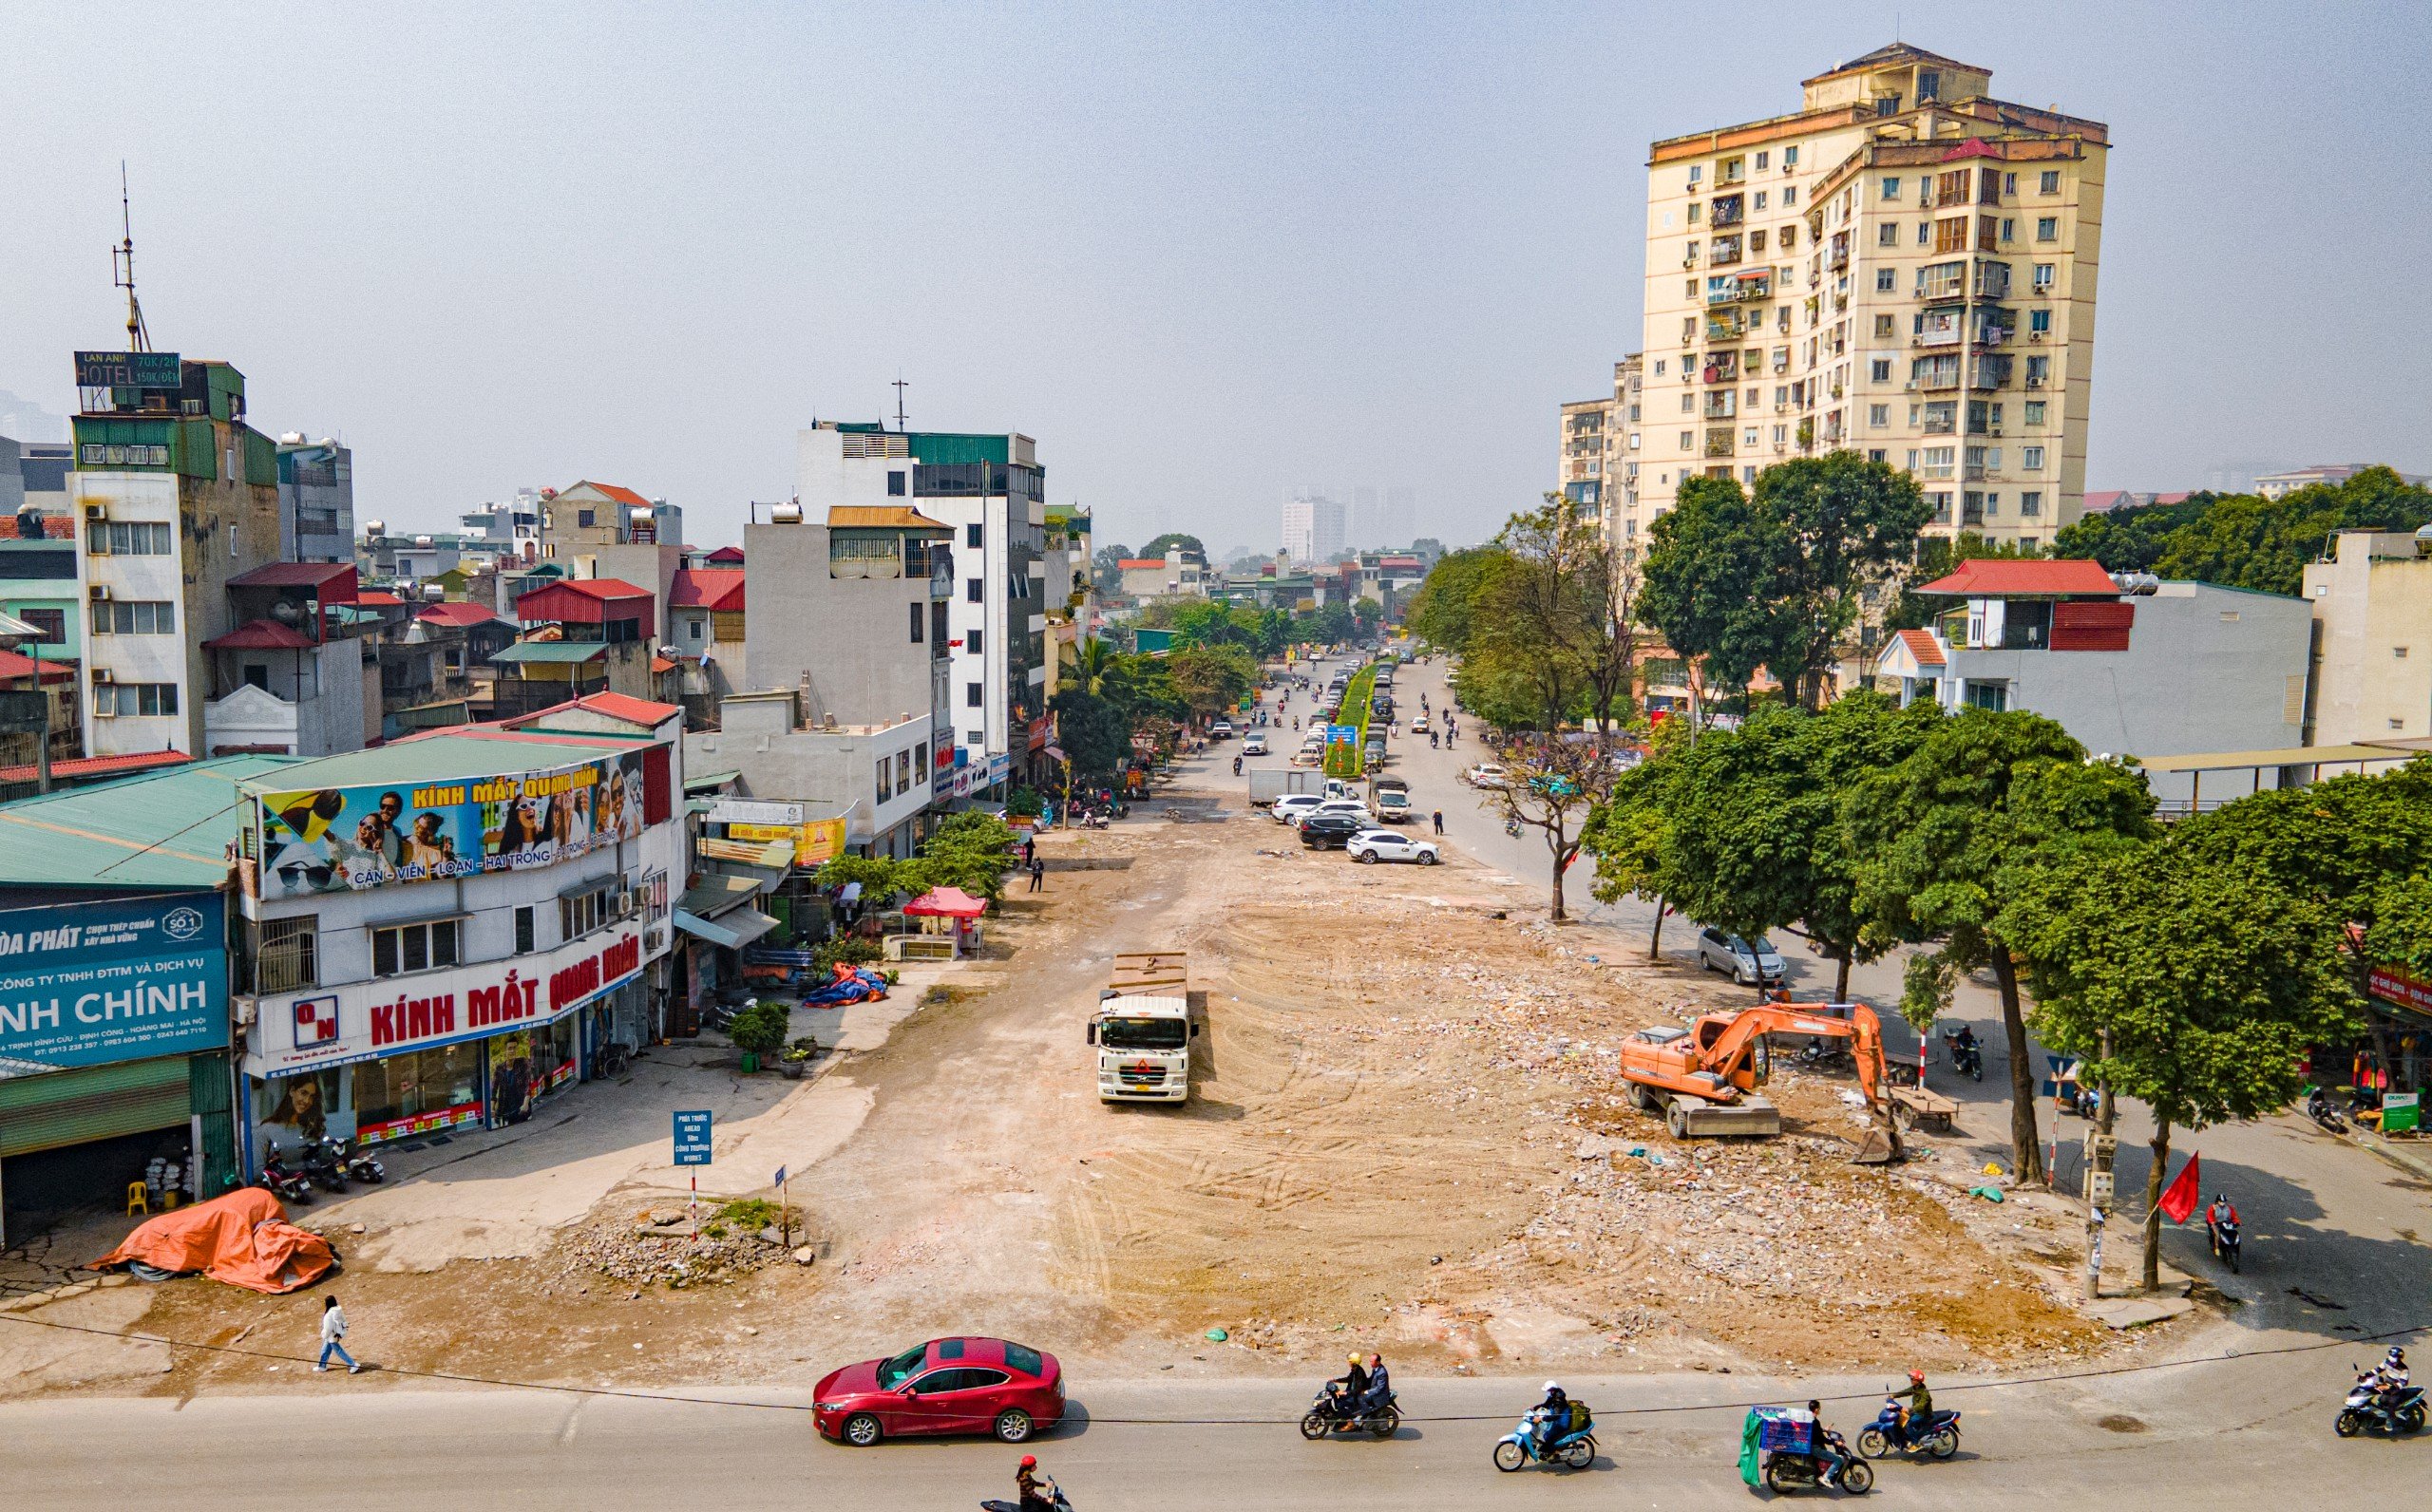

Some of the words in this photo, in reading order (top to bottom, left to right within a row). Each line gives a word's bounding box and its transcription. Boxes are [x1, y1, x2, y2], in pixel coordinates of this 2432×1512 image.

[84, 353, 103, 362] LAN
[104, 353, 125, 363] ANH
[76, 365, 135, 385] HOTEL
[412, 784, 466, 809] KÍNH
[472, 775, 519, 803] MẮT
[523, 772, 571, 799] QUANG
[397, 861, 426, 879] VIỄN
[439, 859, 473, 877] LOẠN
[485, 855, 506, 868] HAI
[170, 915, 186, 929] SỐ
[188, 917, 195, 927] 1
[28, 924, 83, 953] PHÁT
[38, 974, 54, 986] TY
[57, 970, 94, 984] TNHH
[97, 966, 132, 979] ĐTTM
[135, 962, 152, 973] VÀ
[155, 959, 184, 973] DỊCH
[187, 957, 204, 970] VỤ
[74, 979, 207, 1023] CHÍNH
[370, 993, 455, 1046] KÍNH
[467, 968, 540, 1028] MẮT
[549, 954, 599, 1011] QUANG
[602, 932, 639, 985] NHÂN
[8, 1041, 33, 1050] TRỊNH
[180, 1018, 191, 1027] HÀ
